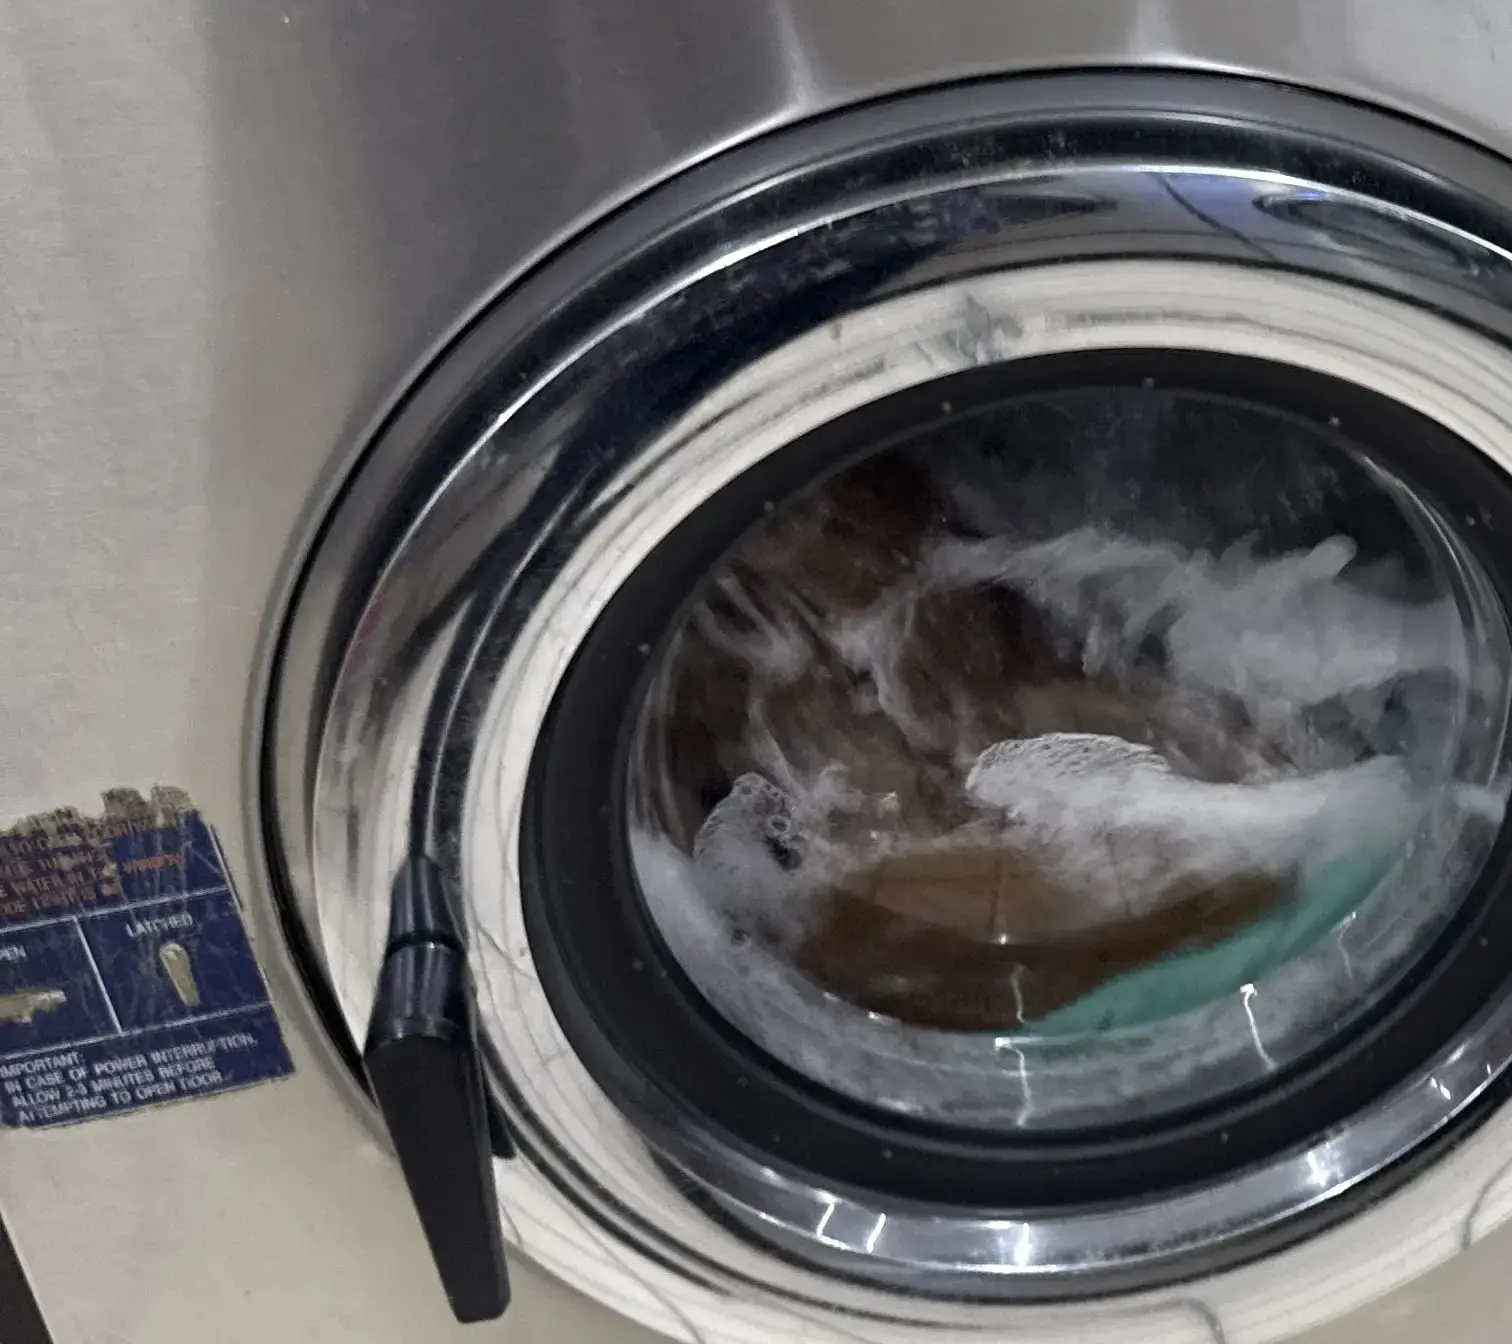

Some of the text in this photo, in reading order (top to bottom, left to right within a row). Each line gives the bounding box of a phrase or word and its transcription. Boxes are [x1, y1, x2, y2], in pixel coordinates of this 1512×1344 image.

[126, 912, 193, 939] LATCHED
[4, 1054, 149, 1094] IN CASE OF POWER
[12, 1089, 60, 1108] ALLOW
[90, 1070, 153, 1093] MINUTES
[158, 1056, 217, 1080] BEFORE
[18, 1096, 107, 1125] ATTEMPTING
[111, 1089, 131, 1105] TO
[137, 1082, 176, 1101] OPEN
